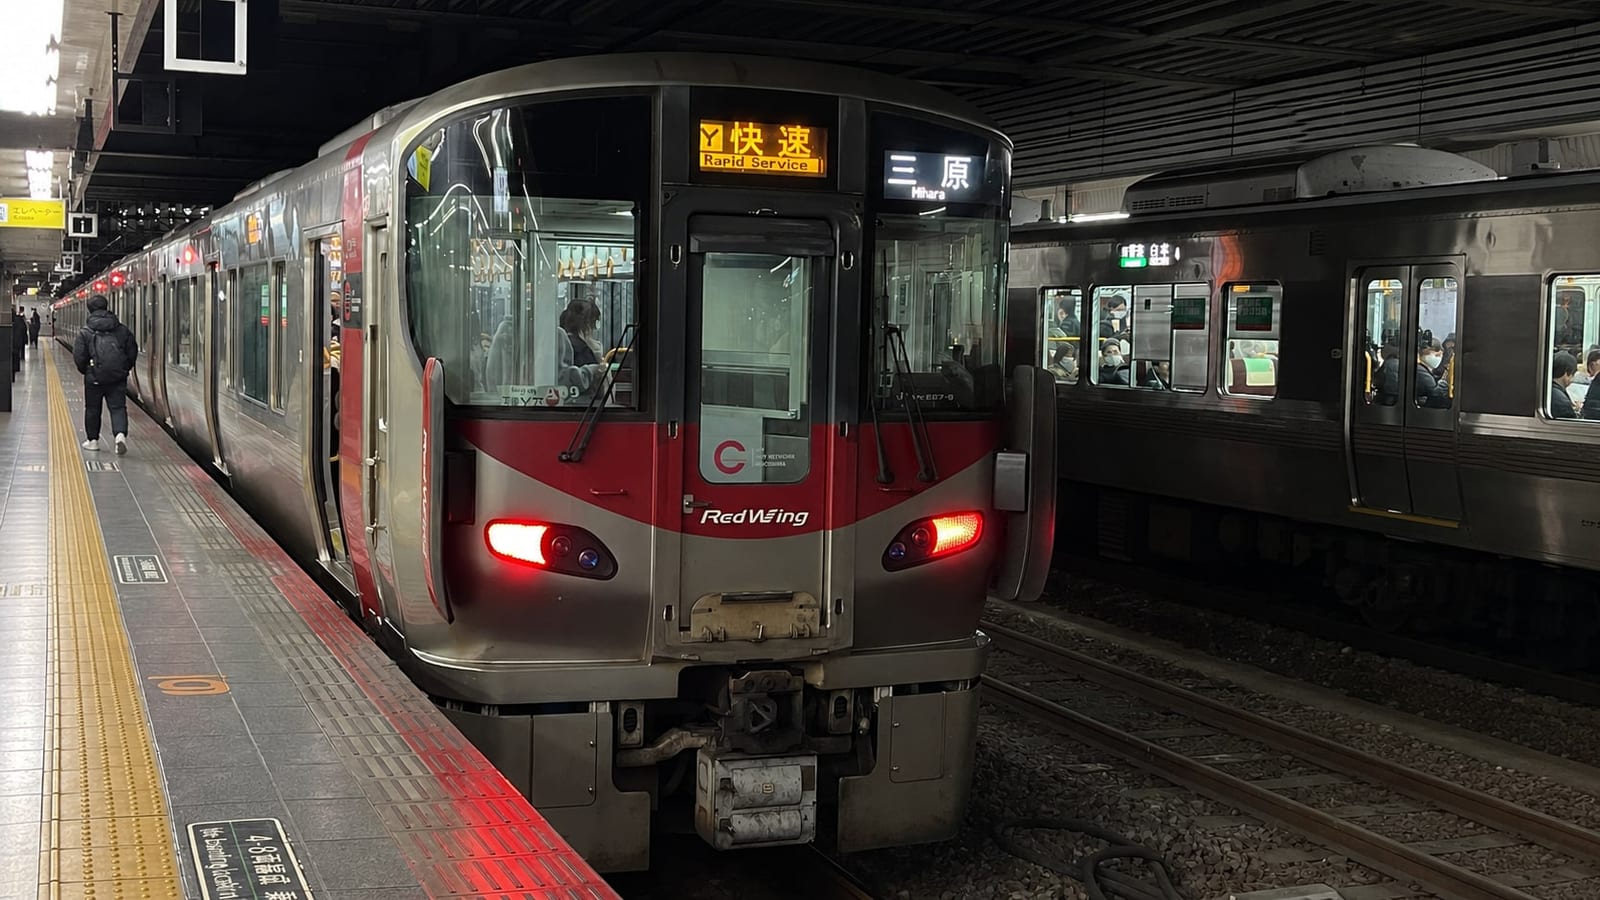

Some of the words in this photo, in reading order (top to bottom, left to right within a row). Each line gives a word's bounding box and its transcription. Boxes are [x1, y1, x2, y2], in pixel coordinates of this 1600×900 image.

[700, 127, 719, 147] Y
[730, 121, 811, 158] 快速
[704, 153, 744, 168] Rapid
[751, 157, 808, 171] Service
[887, 154, 971, 190] 三原
[911, 186, 946, 200] Mihara
